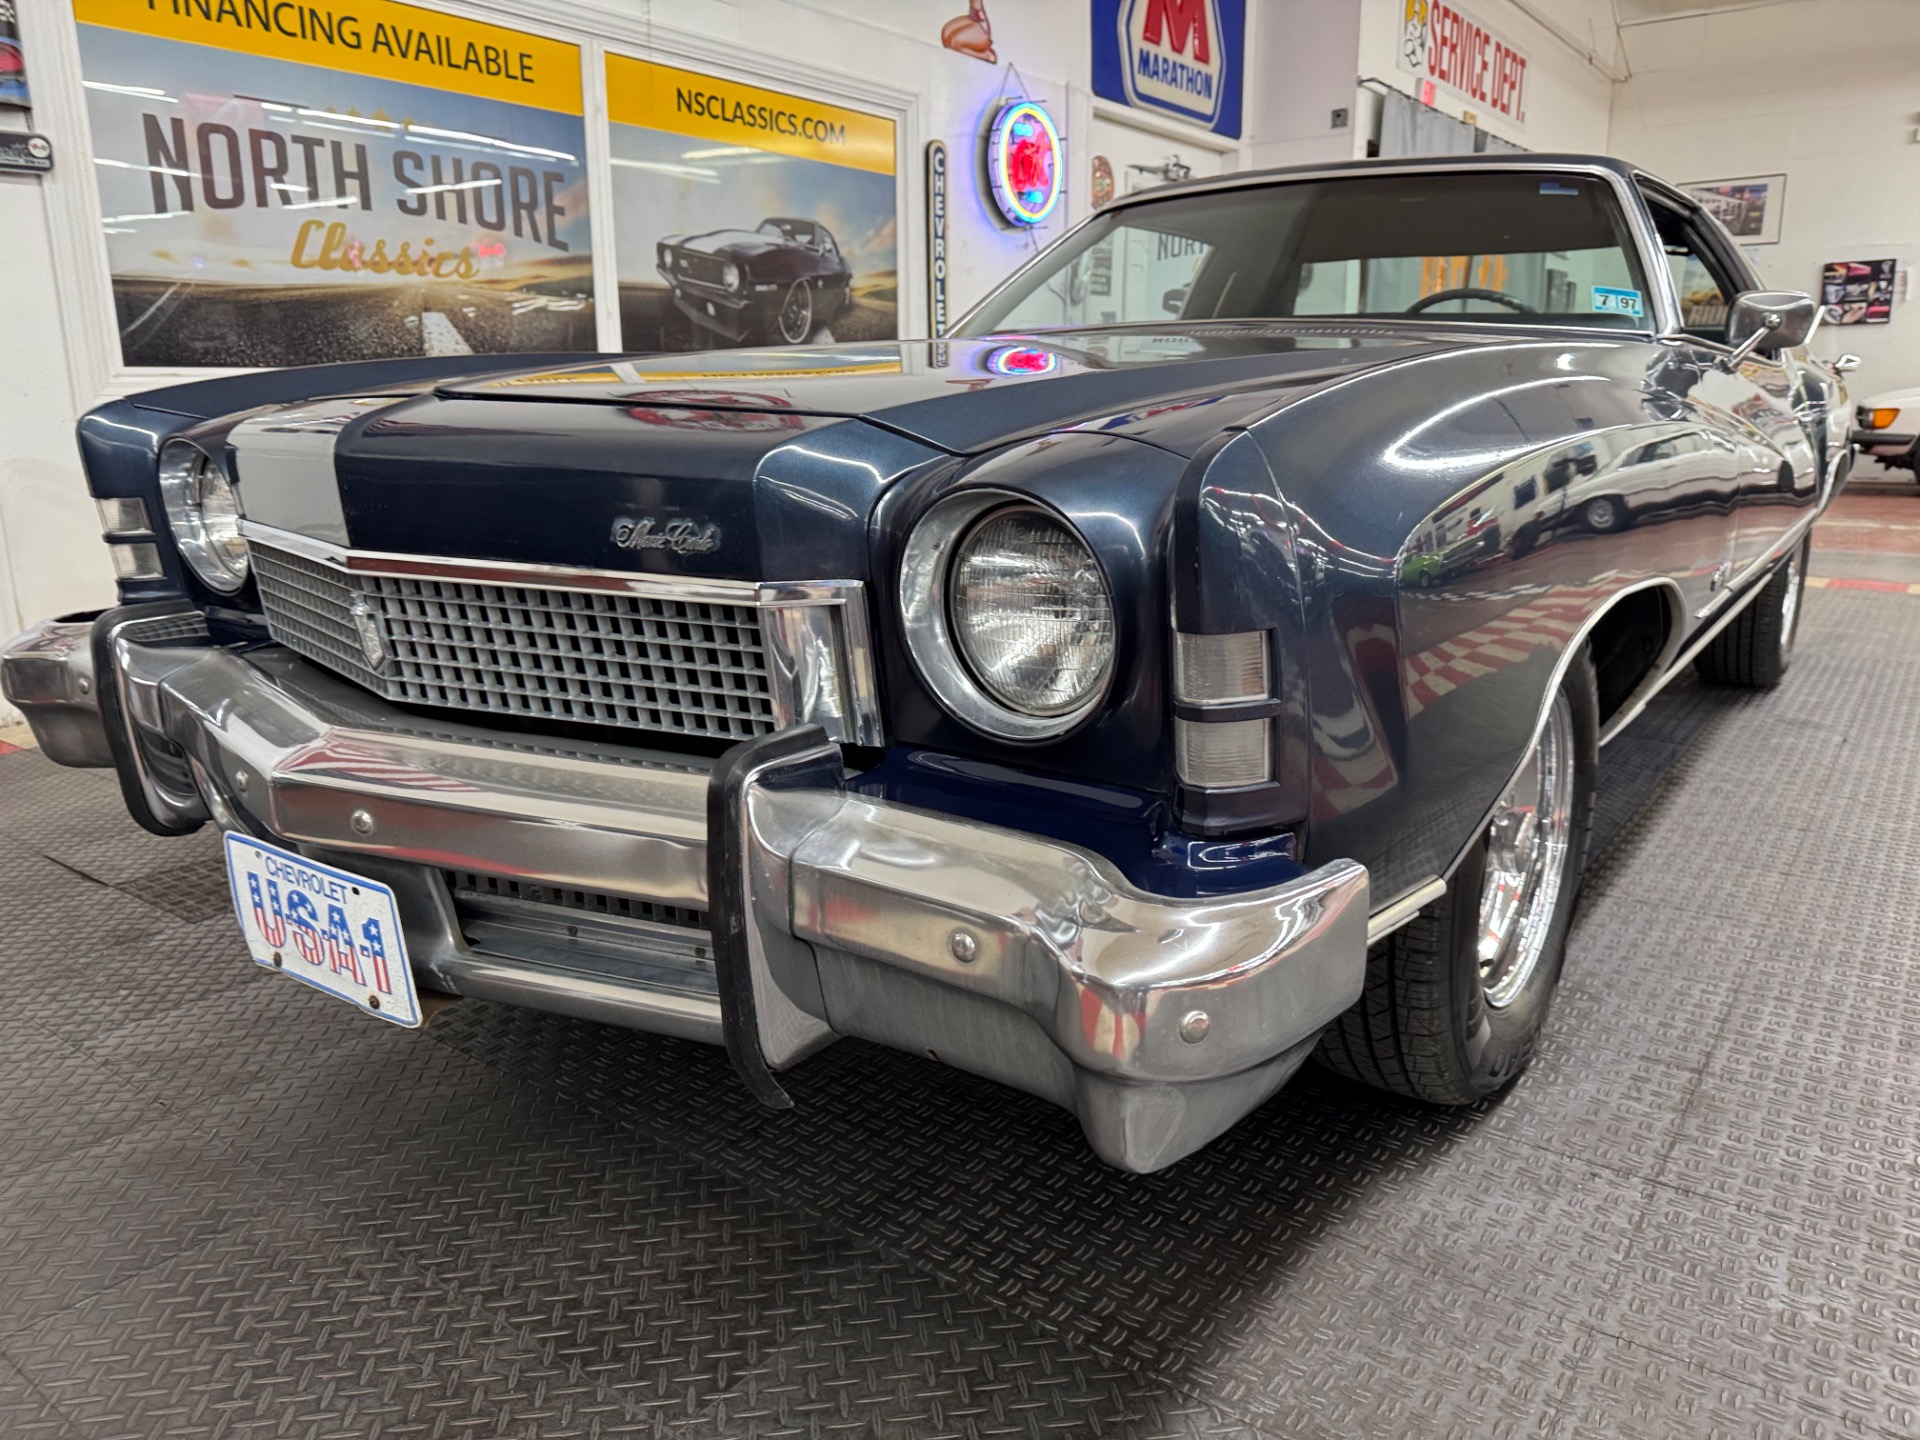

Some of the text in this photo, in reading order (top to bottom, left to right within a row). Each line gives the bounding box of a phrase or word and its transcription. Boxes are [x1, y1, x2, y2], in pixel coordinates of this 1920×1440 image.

[147, 0, 535, 83] NANCING AVAILABLE
[1142, 0, 1210, 66] M
[1428, 0, 1527, 124] SERVICE DEPT.
[1138, 48, 1213, 99] MARATHON
[676, 87, 846, 146] NSCLASSICS.COM
[142, 112, 570, 252] NORTH SHORE
[290, 219, 480, 279] Classics
[1598, 294, 1637, 310] 7 97
[265, 856, 348, 904] CHEVROLET
